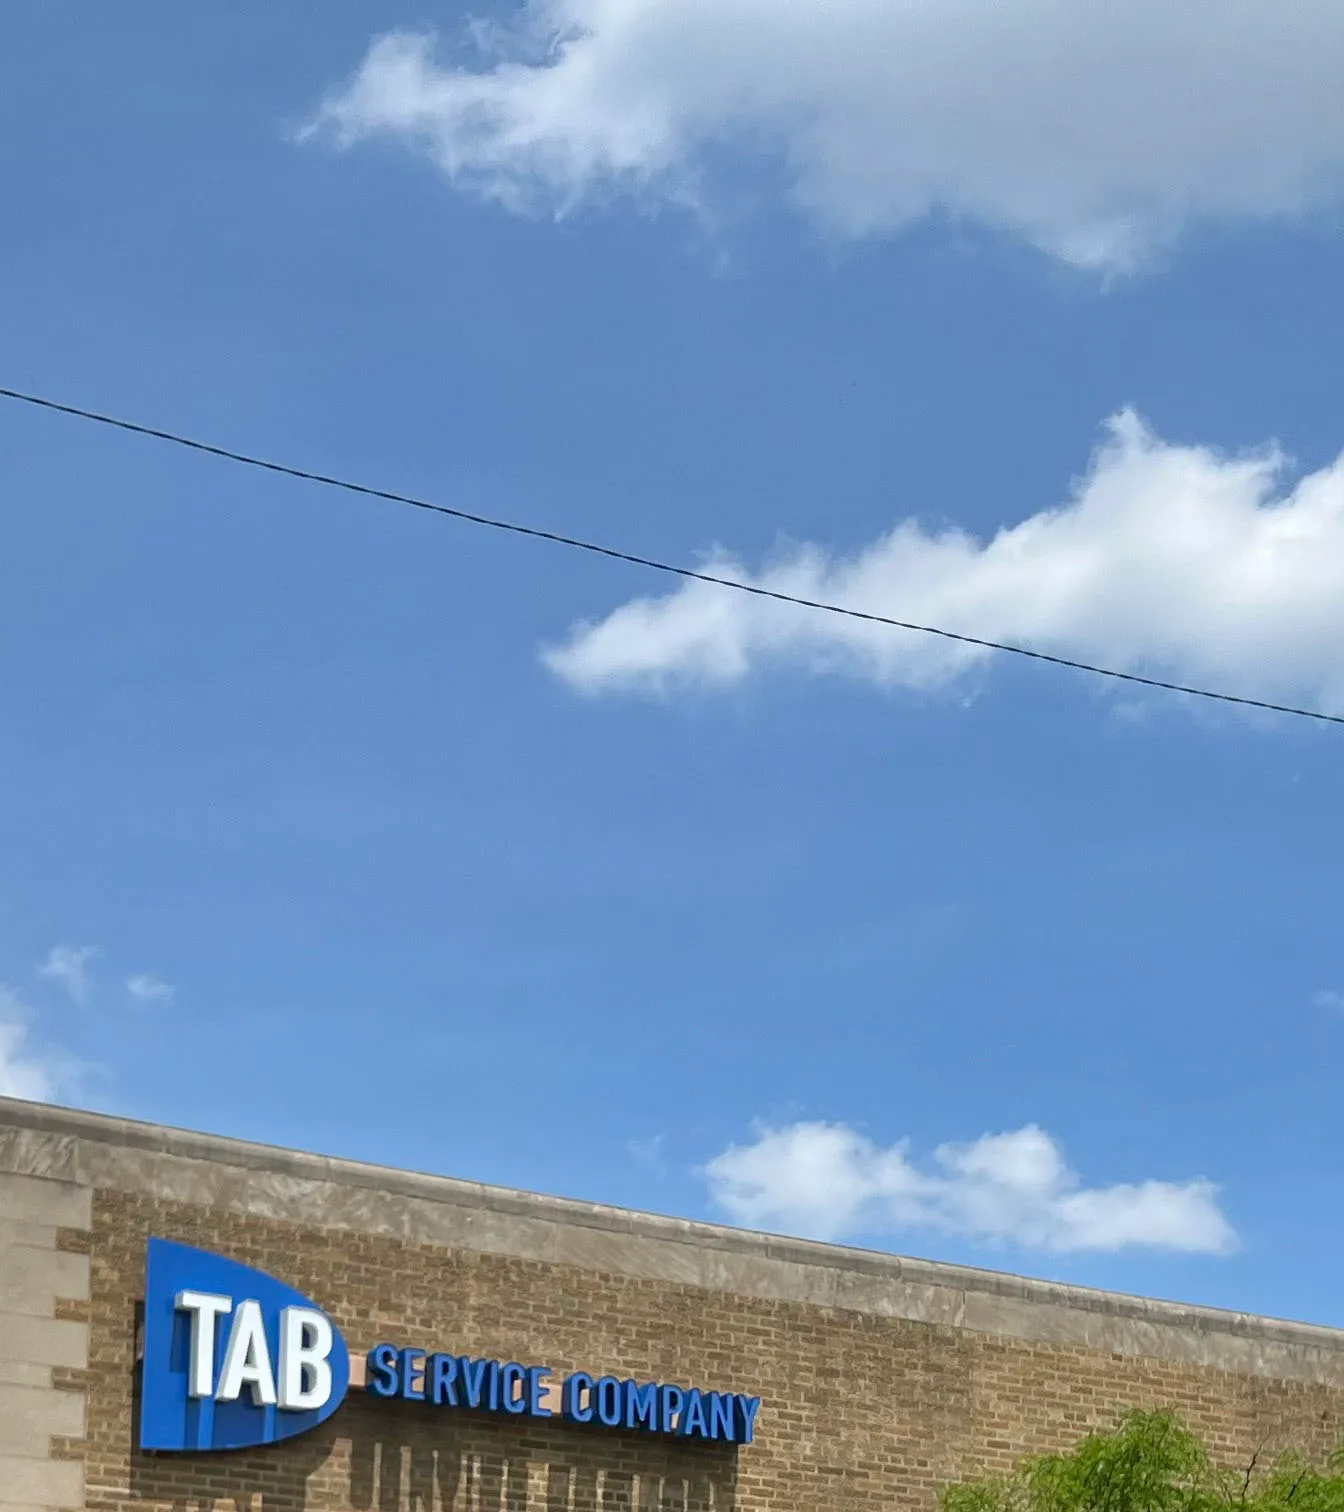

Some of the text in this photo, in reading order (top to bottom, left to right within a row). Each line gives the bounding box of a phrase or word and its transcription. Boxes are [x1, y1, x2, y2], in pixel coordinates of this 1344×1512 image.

[175, 1290, 762, 1444] TAB SERVICE COMPANY
